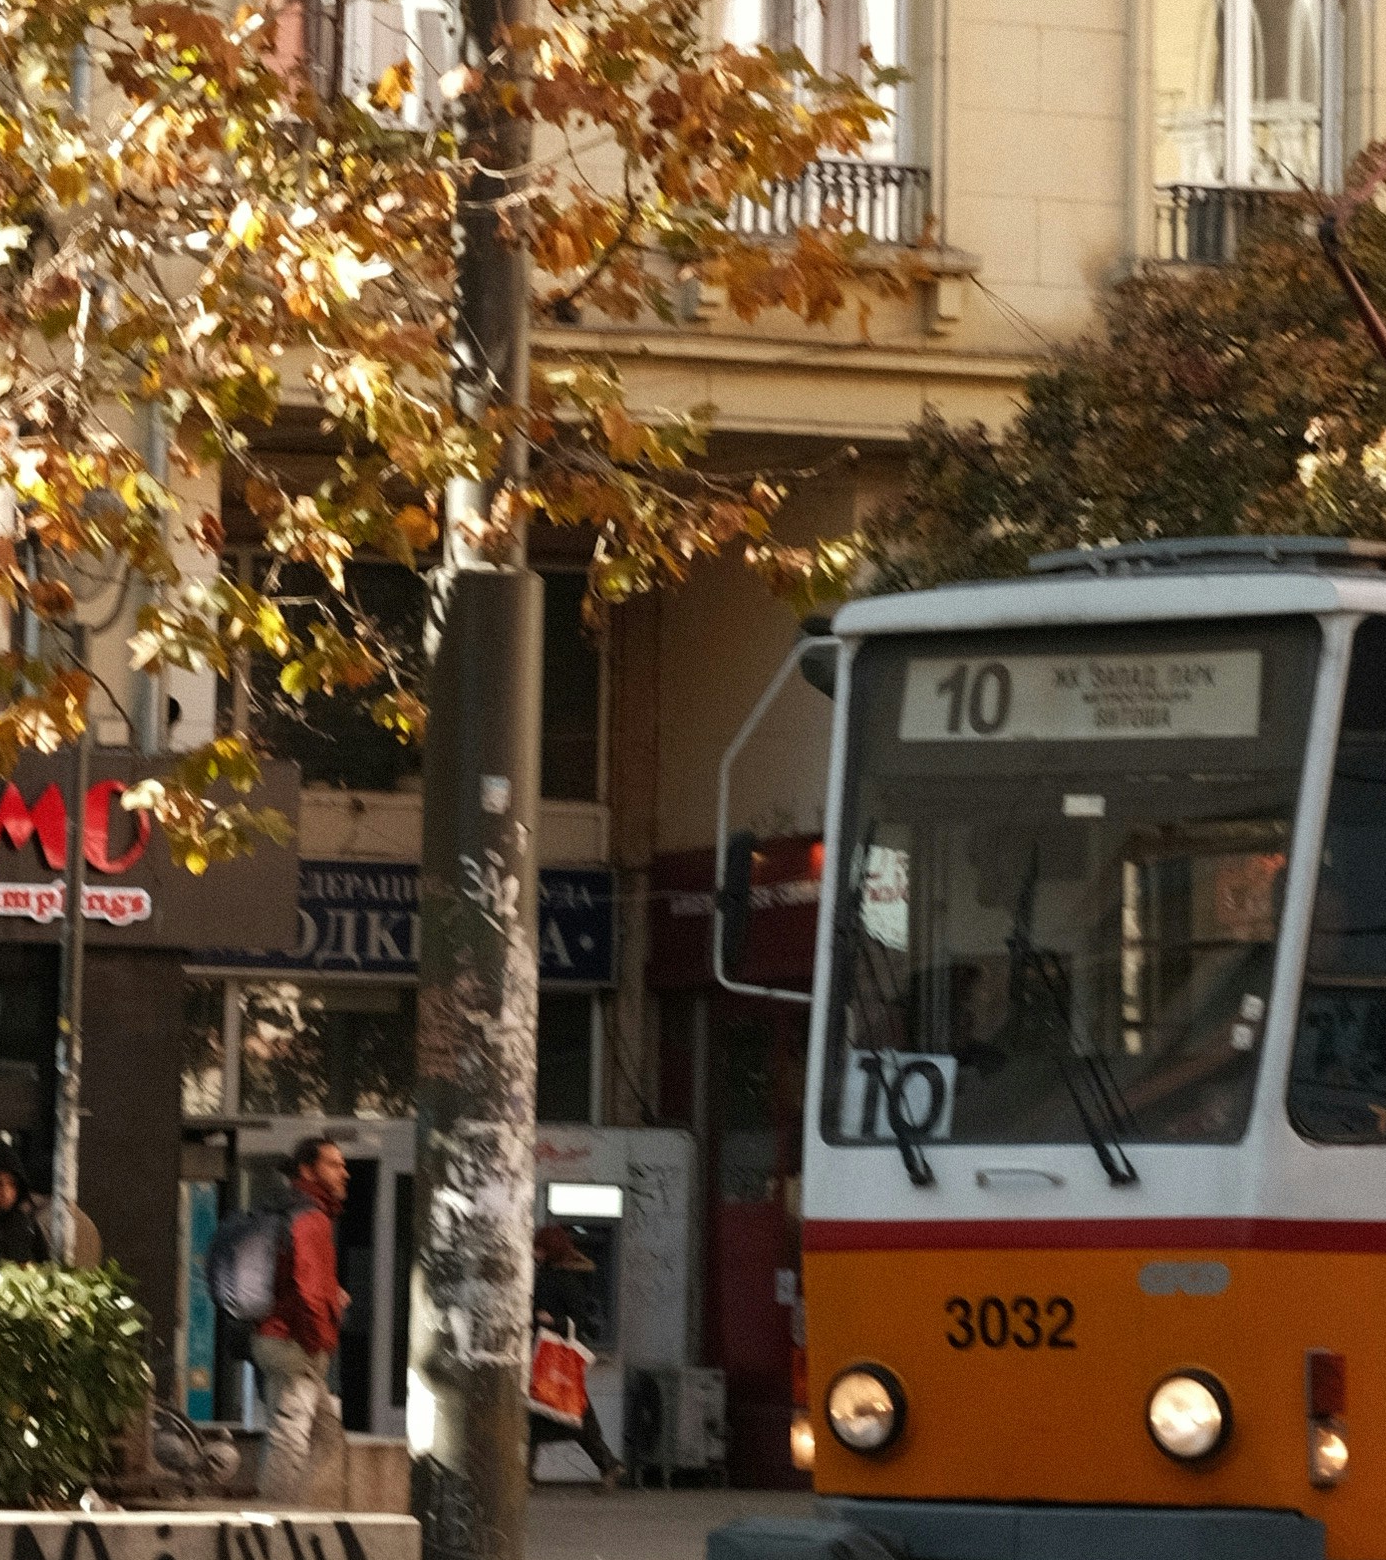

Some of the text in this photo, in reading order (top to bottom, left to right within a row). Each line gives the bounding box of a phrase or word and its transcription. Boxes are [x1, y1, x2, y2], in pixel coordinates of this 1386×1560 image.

[935, 661, 1014, 736] 10
[859, 1056, 946, 1138] 10
[943, 1296, 1078, 1350] 3032
